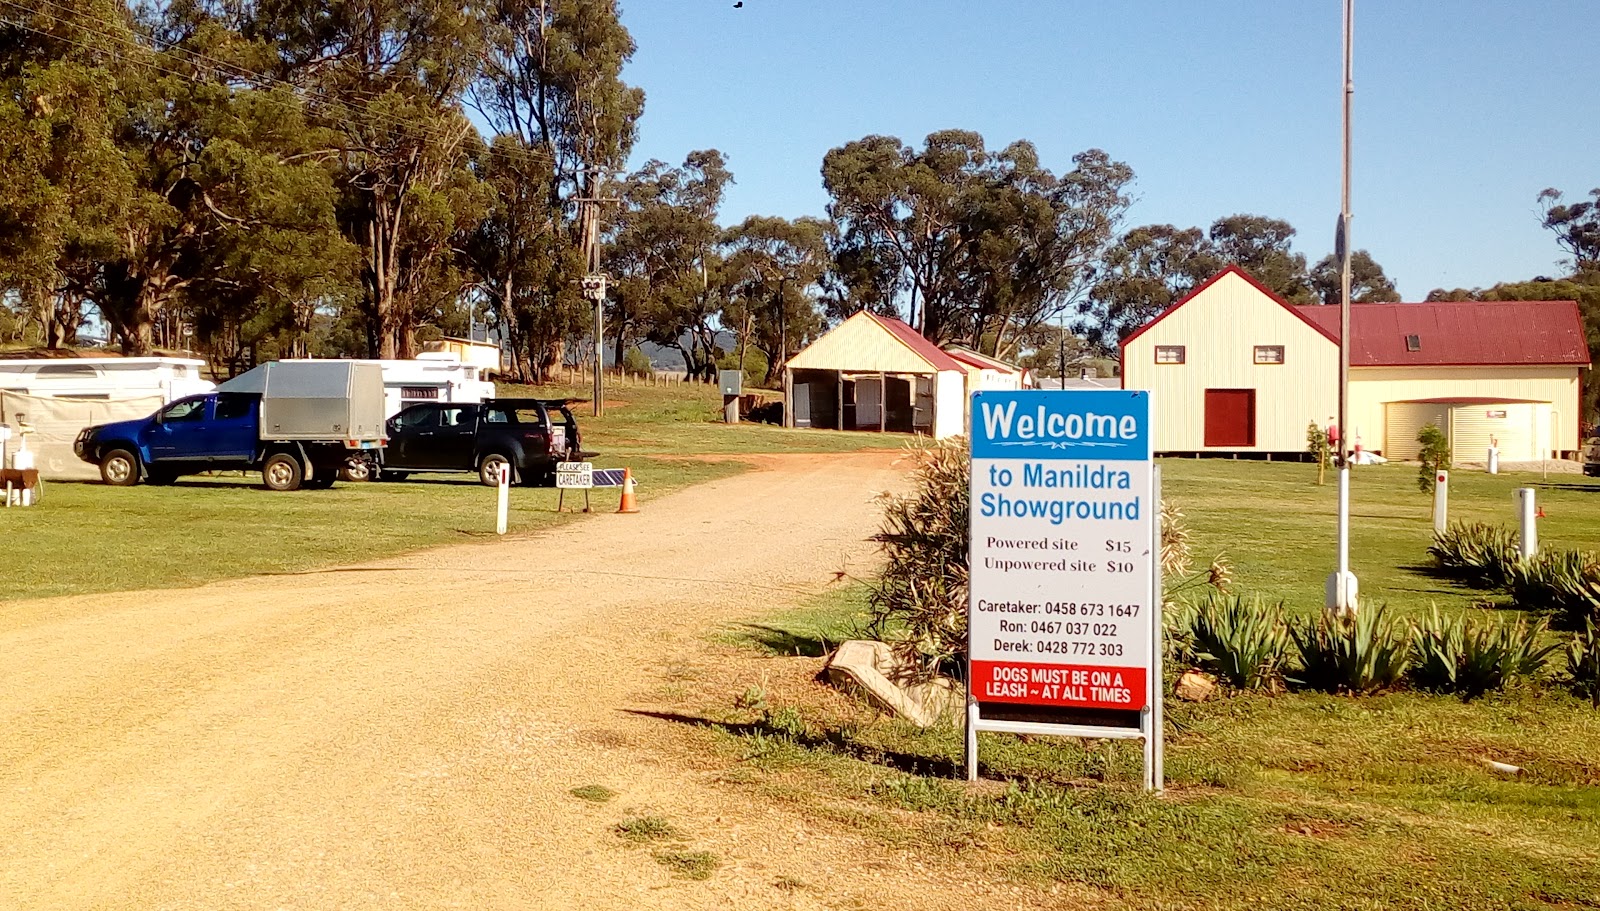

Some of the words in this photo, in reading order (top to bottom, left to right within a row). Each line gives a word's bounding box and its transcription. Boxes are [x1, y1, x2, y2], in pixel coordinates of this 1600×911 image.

[981, 400, 1138, 440] Welcome
[580, 463, 590, 471] SEE
[559, 474, 590, 485] CARETAKER
[989, 464, 1012, 487] to
[1023, 463, 1130, 489] Manildra
[980, 492, 1139, 525] Showground
[987, 536, 1048, 550] Powered
[1052, 538, 1078, 551] site
[1105, 540, 1131, 553] $15
[984, 557, 1066, 572] Unpowered
[1070, 560, 1097, 572] site
[1107, 560, 1134, 573] $10
[978, 600, 1041, 614] Caretaker:
[1045, 602, 1076, 615] 0458
[1080, 603, 1104, 616] 673
[1108, 604, 1140, 617] 1647
[1000, 620, 1027, 633] Ron:
[1031, 620, 1062, 634] 0467
[1066, 622, 1089, 635] 037
[1093, 624, 1117, 637] 022
[994, 639, 1033, 653] Derek:
[1037, 640, 1068, 654] 0428
[1072, 642, 1095, 655] 772
[1099, 643, 1123, 656] 303
[993, 666, 1028, 683] DOGS
[1031, 668, 1069, 685] MUST
[1071, 670, 1088, 686] BE
[1091, 671, 1110, 686] ON
[1113, 672, 1124, 687] A
[986, 681, 1027, 698] LEASH
[1042, 684, 1060, 699] AT
[1062, 685, 1087, 701] ALL
[1090, 686, 1131, 703] TIMES
